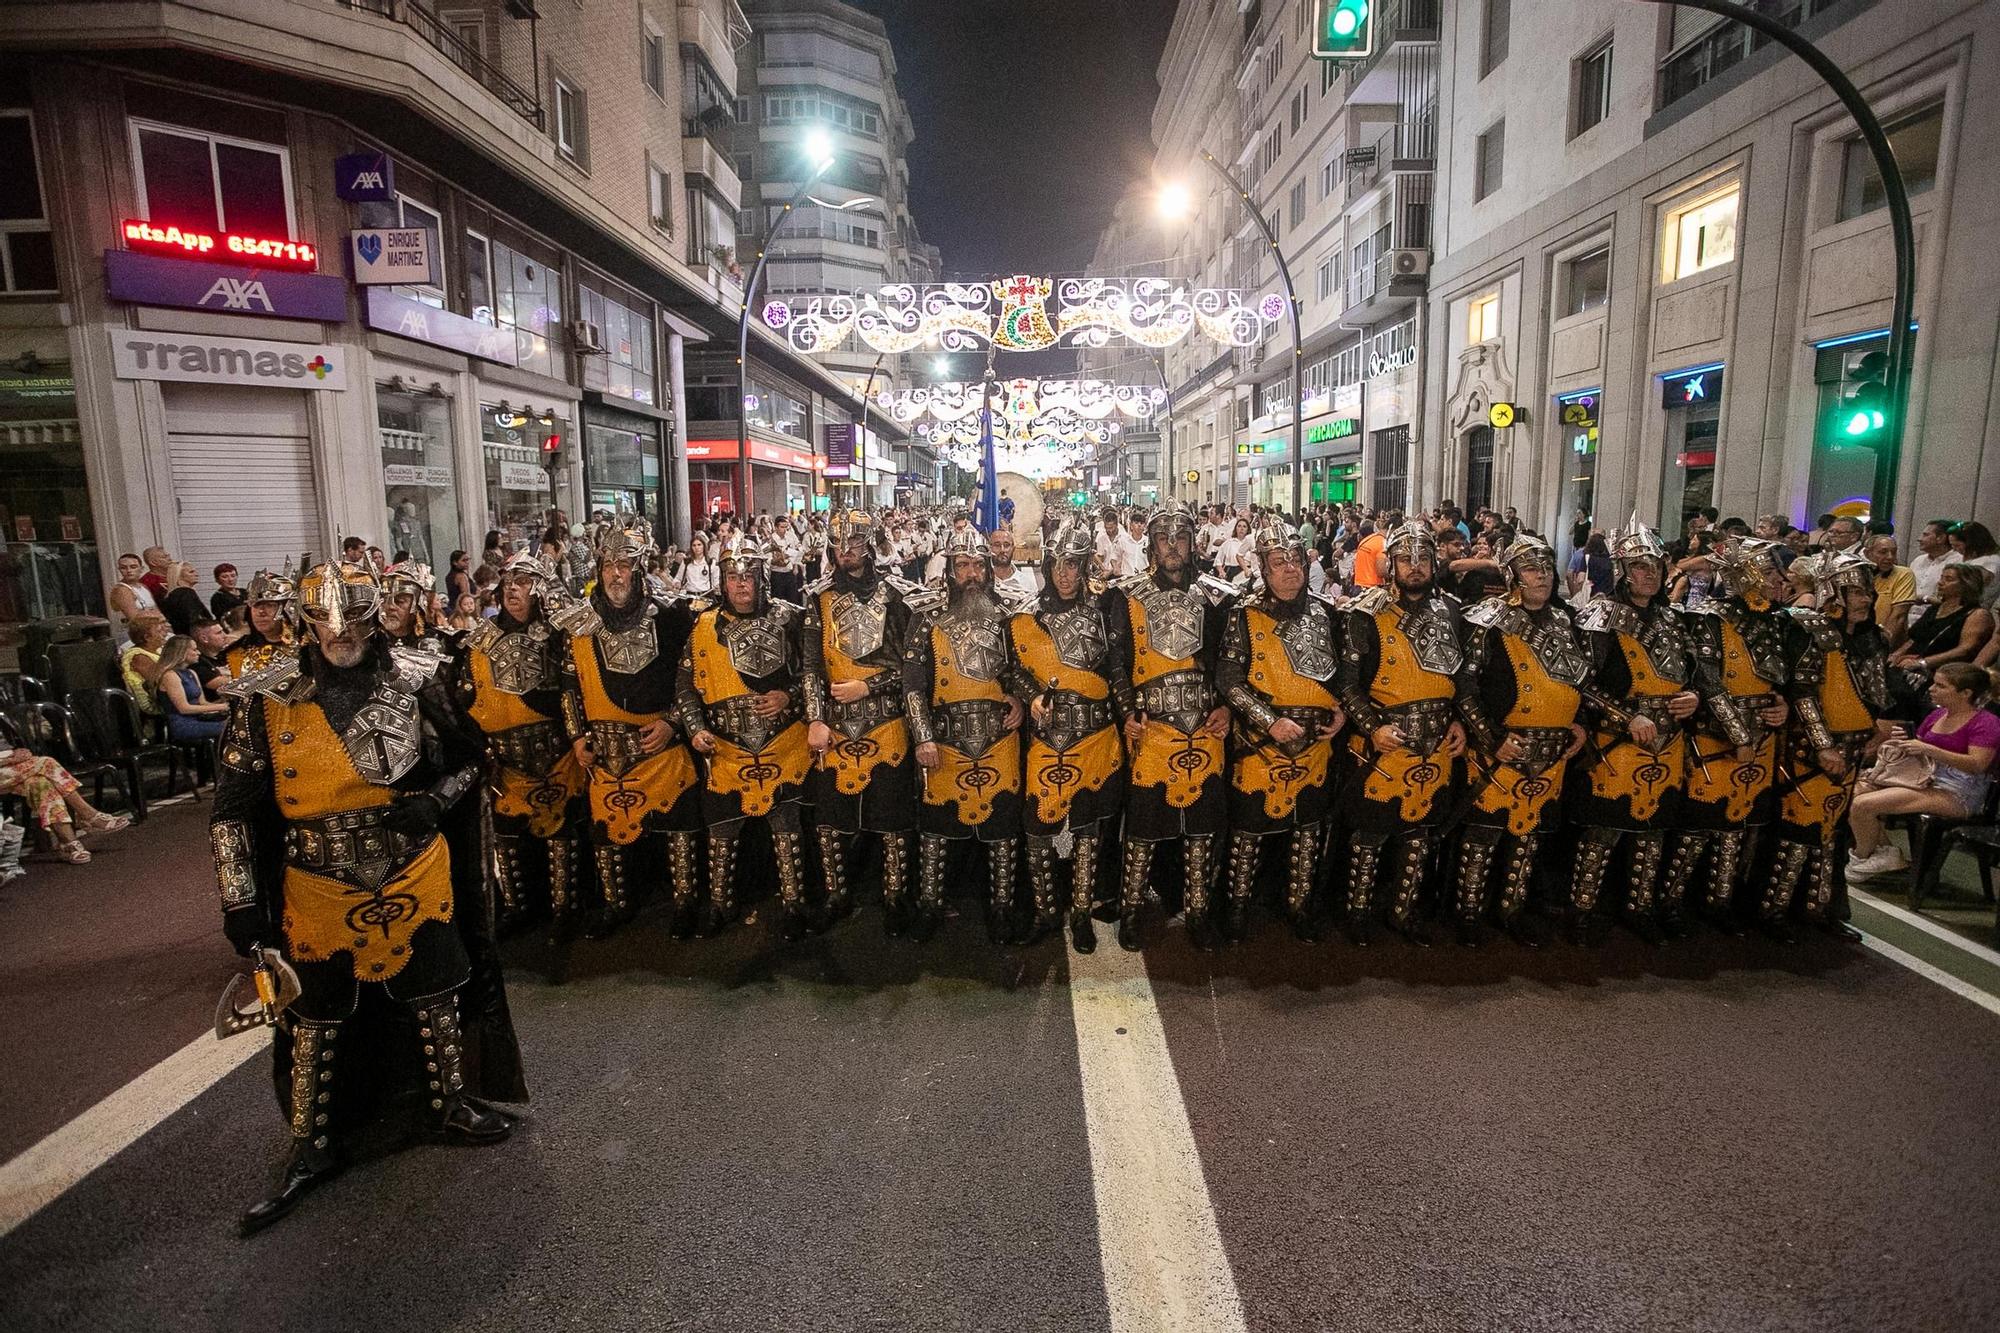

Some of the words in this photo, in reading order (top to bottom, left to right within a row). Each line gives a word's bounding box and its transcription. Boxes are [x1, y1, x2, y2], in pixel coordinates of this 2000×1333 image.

[351, 172, 384, 189] AXA
[228, 236, 315, 262] 654711
[388, 232, 420, 247] ENRIQUE
[387, 251, 423, 267] MARTINEZ
[197, 277, 275, 312] AXA
[399, 309, 431, 340] AXA
[475, 333, 500, 359] AXA
[1308, 418, 1352, 443] MERCADONA
